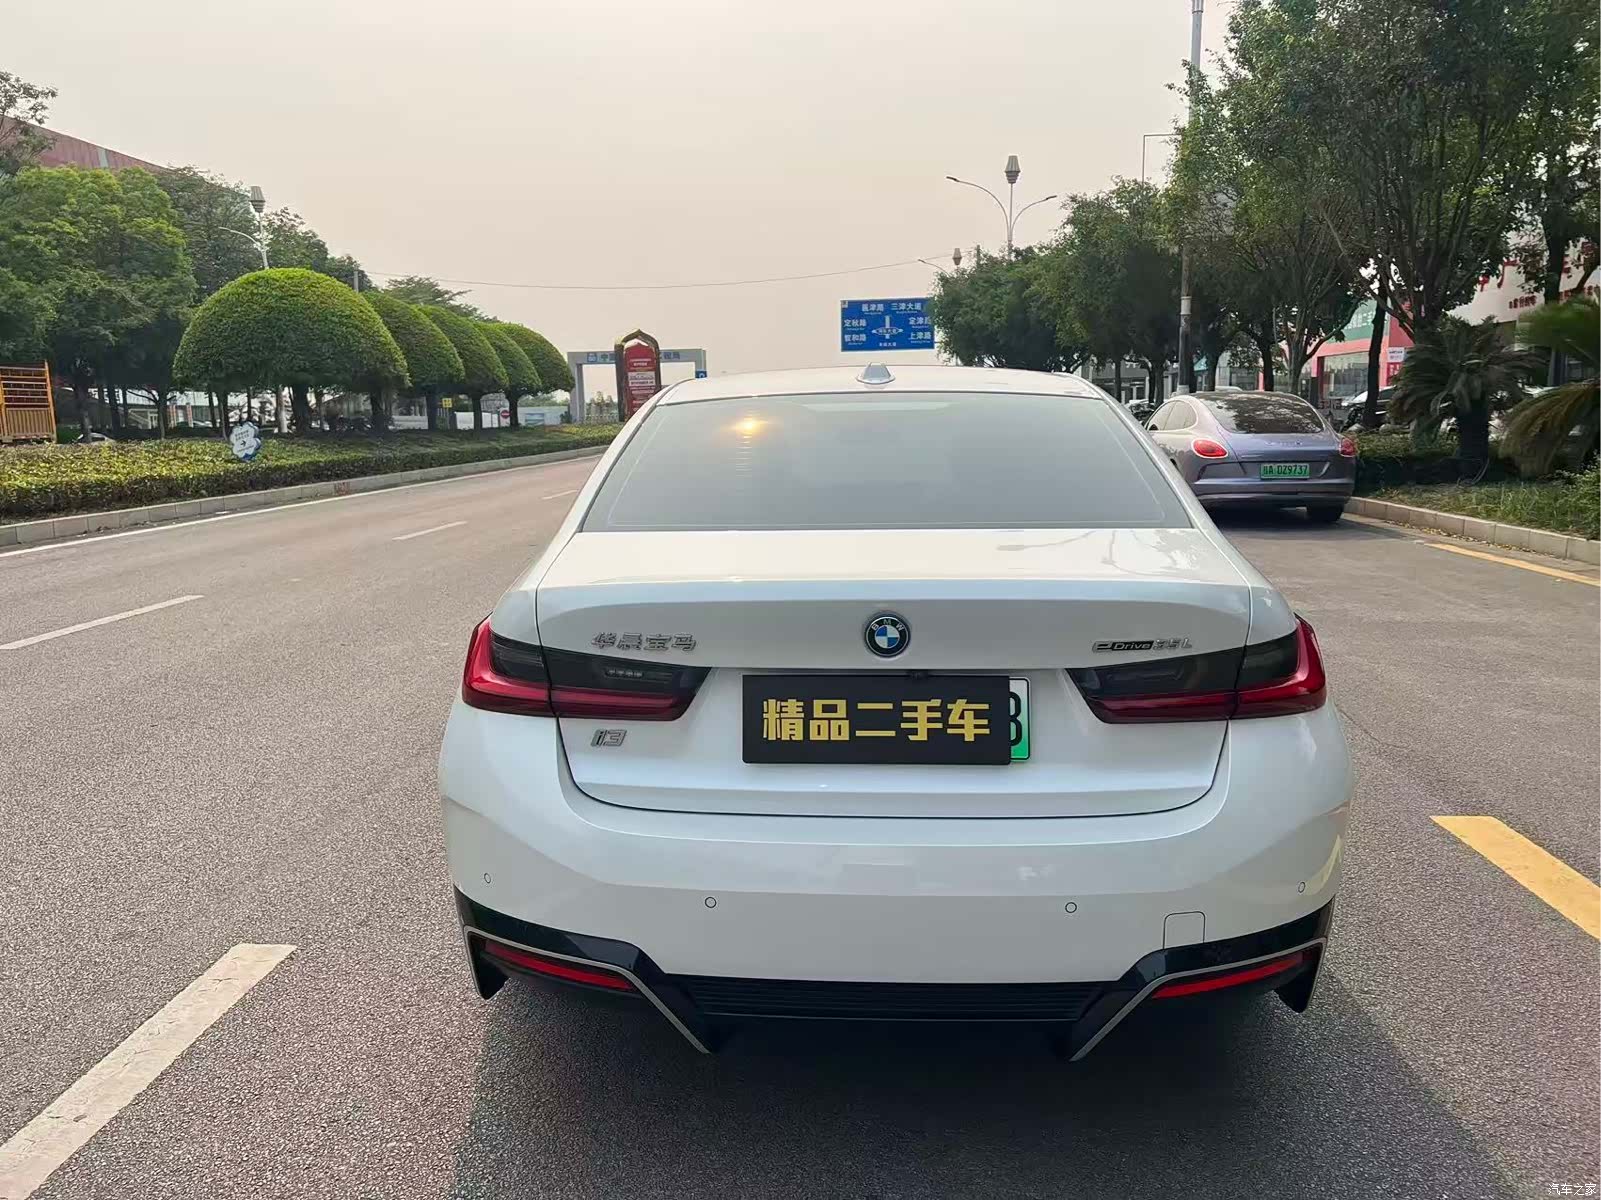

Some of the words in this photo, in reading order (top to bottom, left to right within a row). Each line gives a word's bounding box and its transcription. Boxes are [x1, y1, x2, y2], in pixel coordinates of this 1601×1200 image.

[871, 619, 905, 631] BMW
[591, 632, 697, 651] 华晨宝马
[762, 698, 991, 742] 精品二手车
[590, 729, 628, 747] i3
